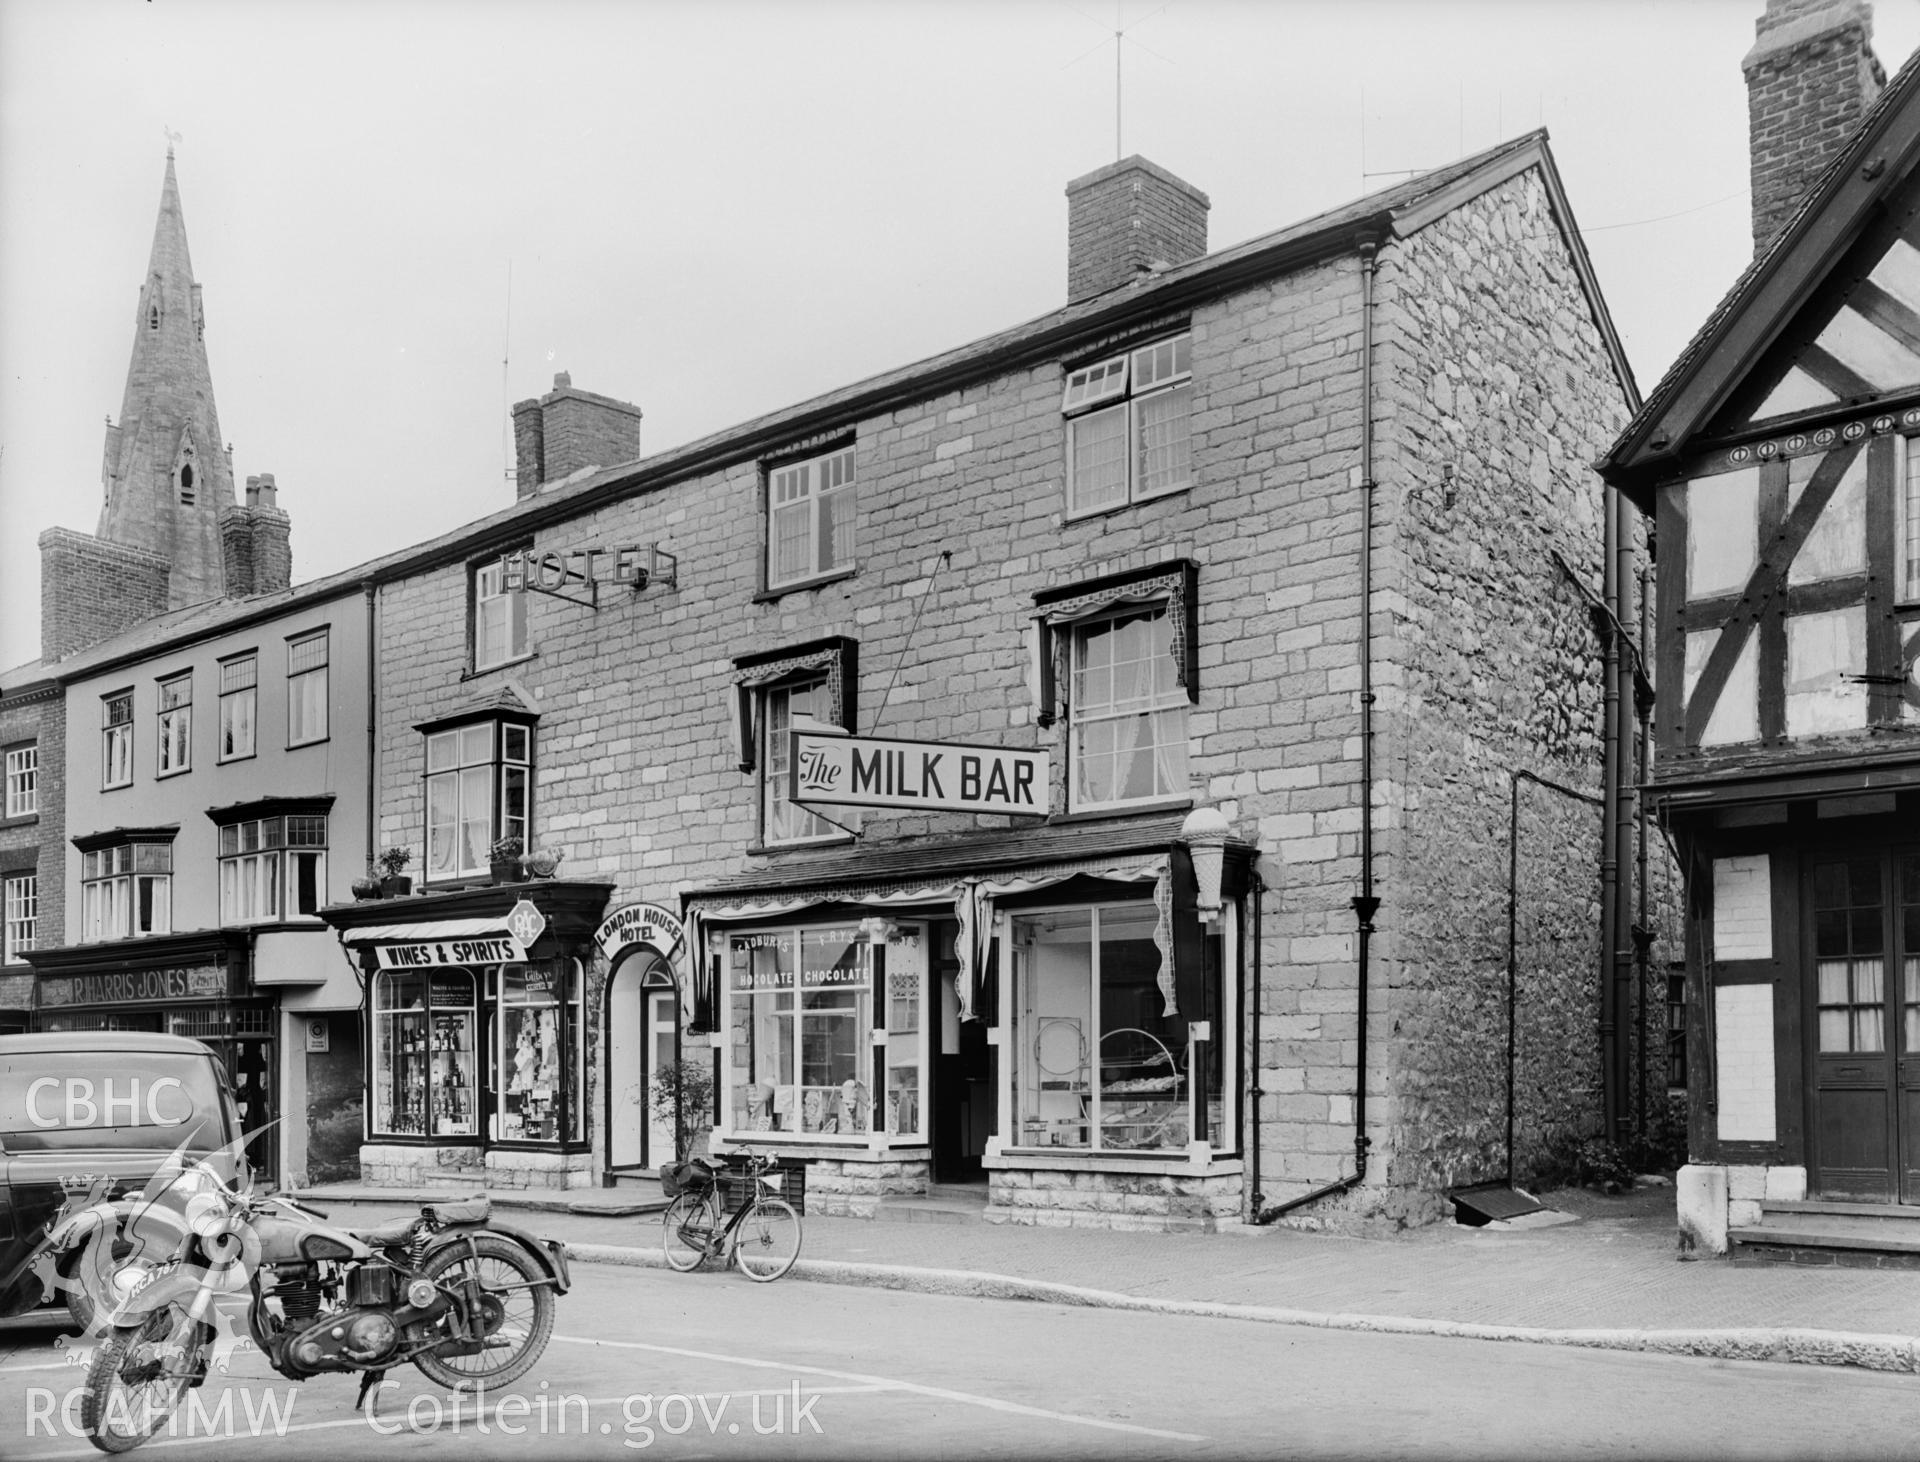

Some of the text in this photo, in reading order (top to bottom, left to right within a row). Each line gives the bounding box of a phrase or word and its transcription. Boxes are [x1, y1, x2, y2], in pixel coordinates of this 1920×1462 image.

[500, 543, 675, 594] HOTEL
[799, 748, 1034, 805] The MILK BAR
[597, 908, 682, 946] LONDON HOUSE
[620, 926, 656, 943] HOTEL
[386, 940, 515, 966] WINES & SPIRITS
[137, 969, 185, 998] JONES
[805, 968, 869, 983] CHOCOLATE
